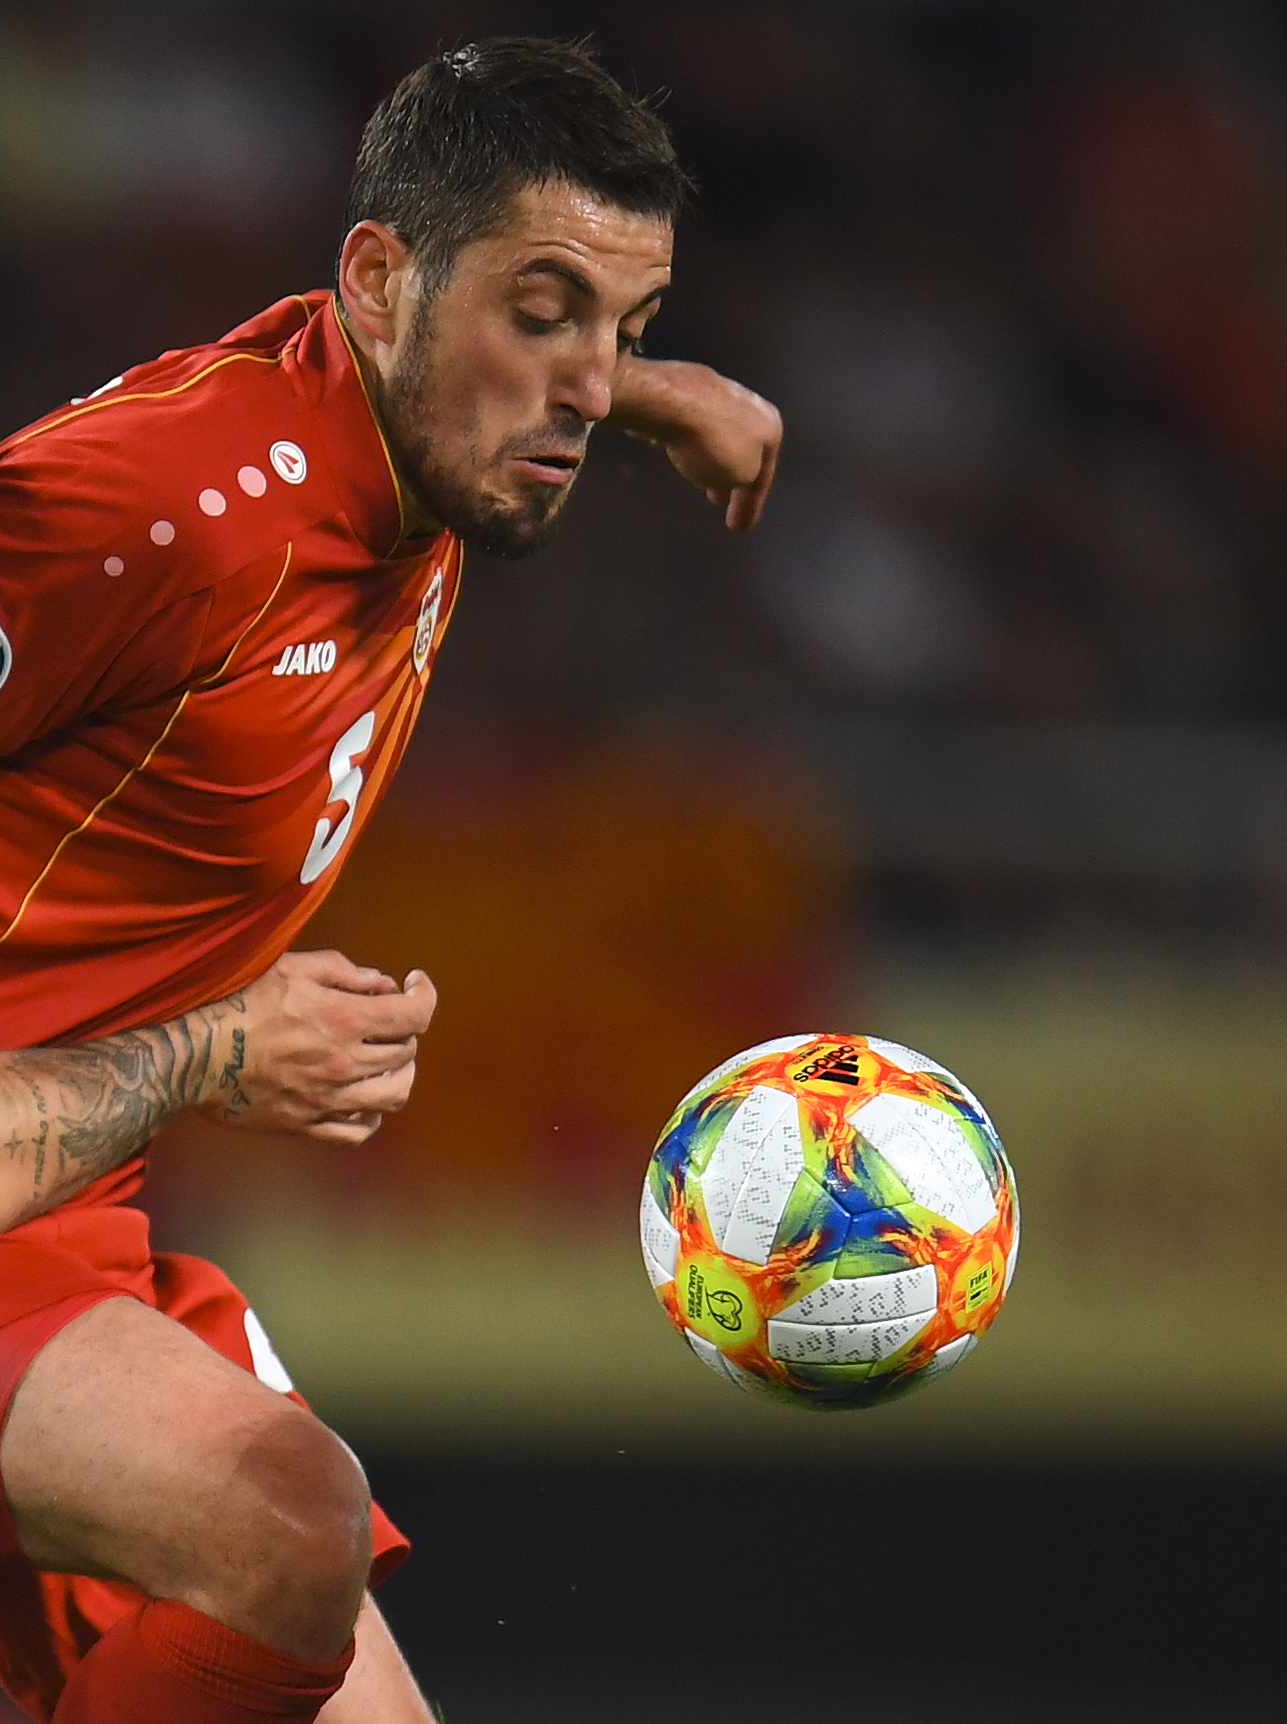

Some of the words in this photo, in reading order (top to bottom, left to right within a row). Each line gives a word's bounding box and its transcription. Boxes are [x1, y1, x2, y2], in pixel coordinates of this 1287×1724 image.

[272, 639, 337, 676] JAKO
[300, 710, 376, 884] 5
[793, 1045, 855, 1083] adidas
